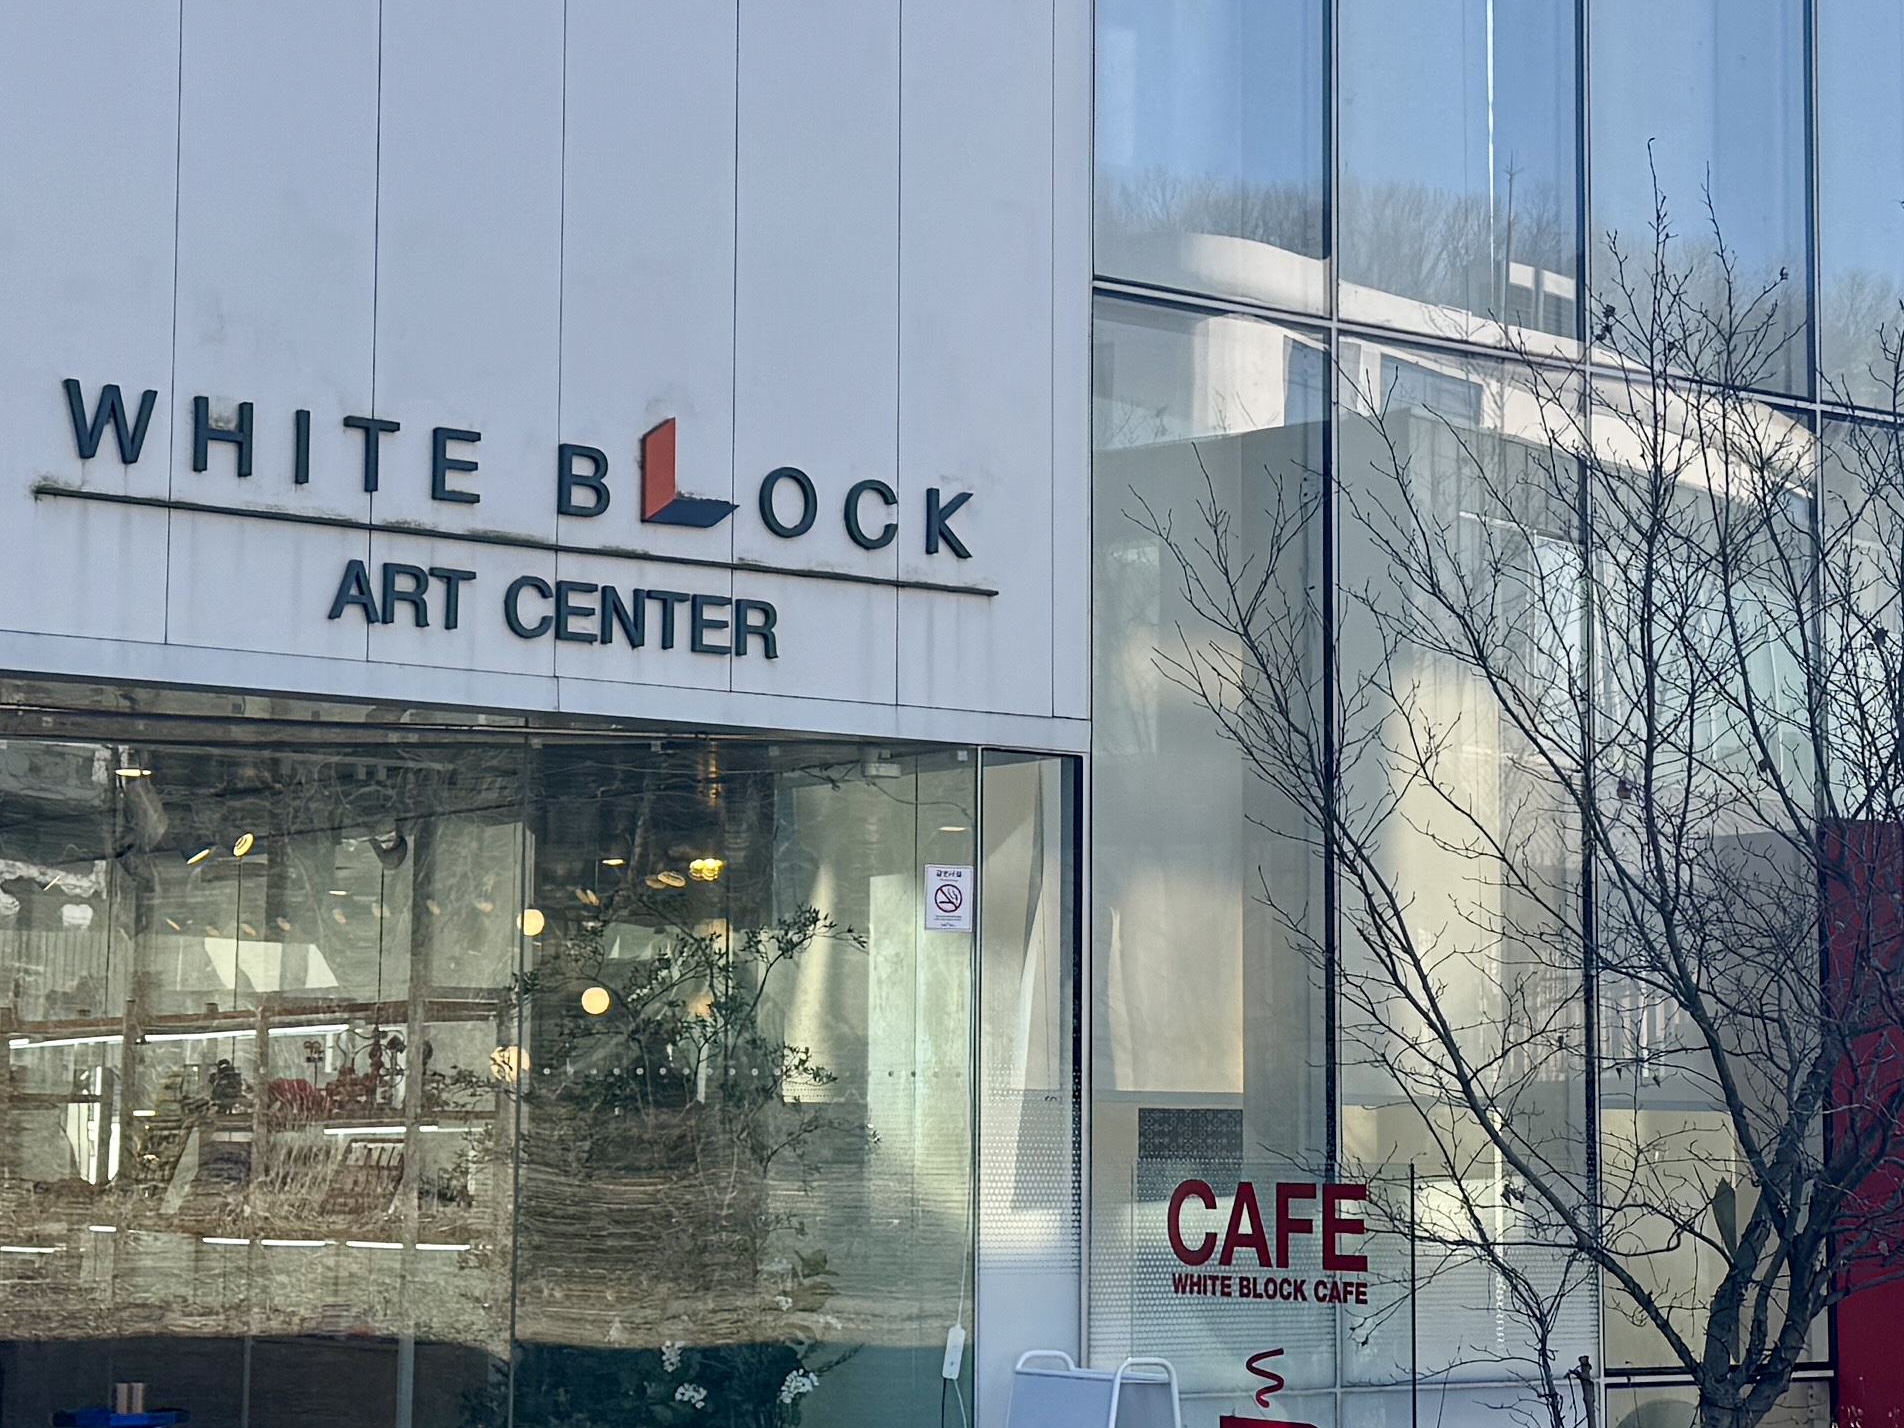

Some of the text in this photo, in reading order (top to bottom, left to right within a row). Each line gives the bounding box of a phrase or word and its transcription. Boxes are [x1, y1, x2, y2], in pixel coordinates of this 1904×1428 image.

[63, 378, 973, 559] WHITE BLOCK
[328, 559, 779, 659] ART CENTER
[1167, 1178, 1368, 1272] CAFE
[1172, 1272, 1368, 1306] WHITE BLOCK CAFE
